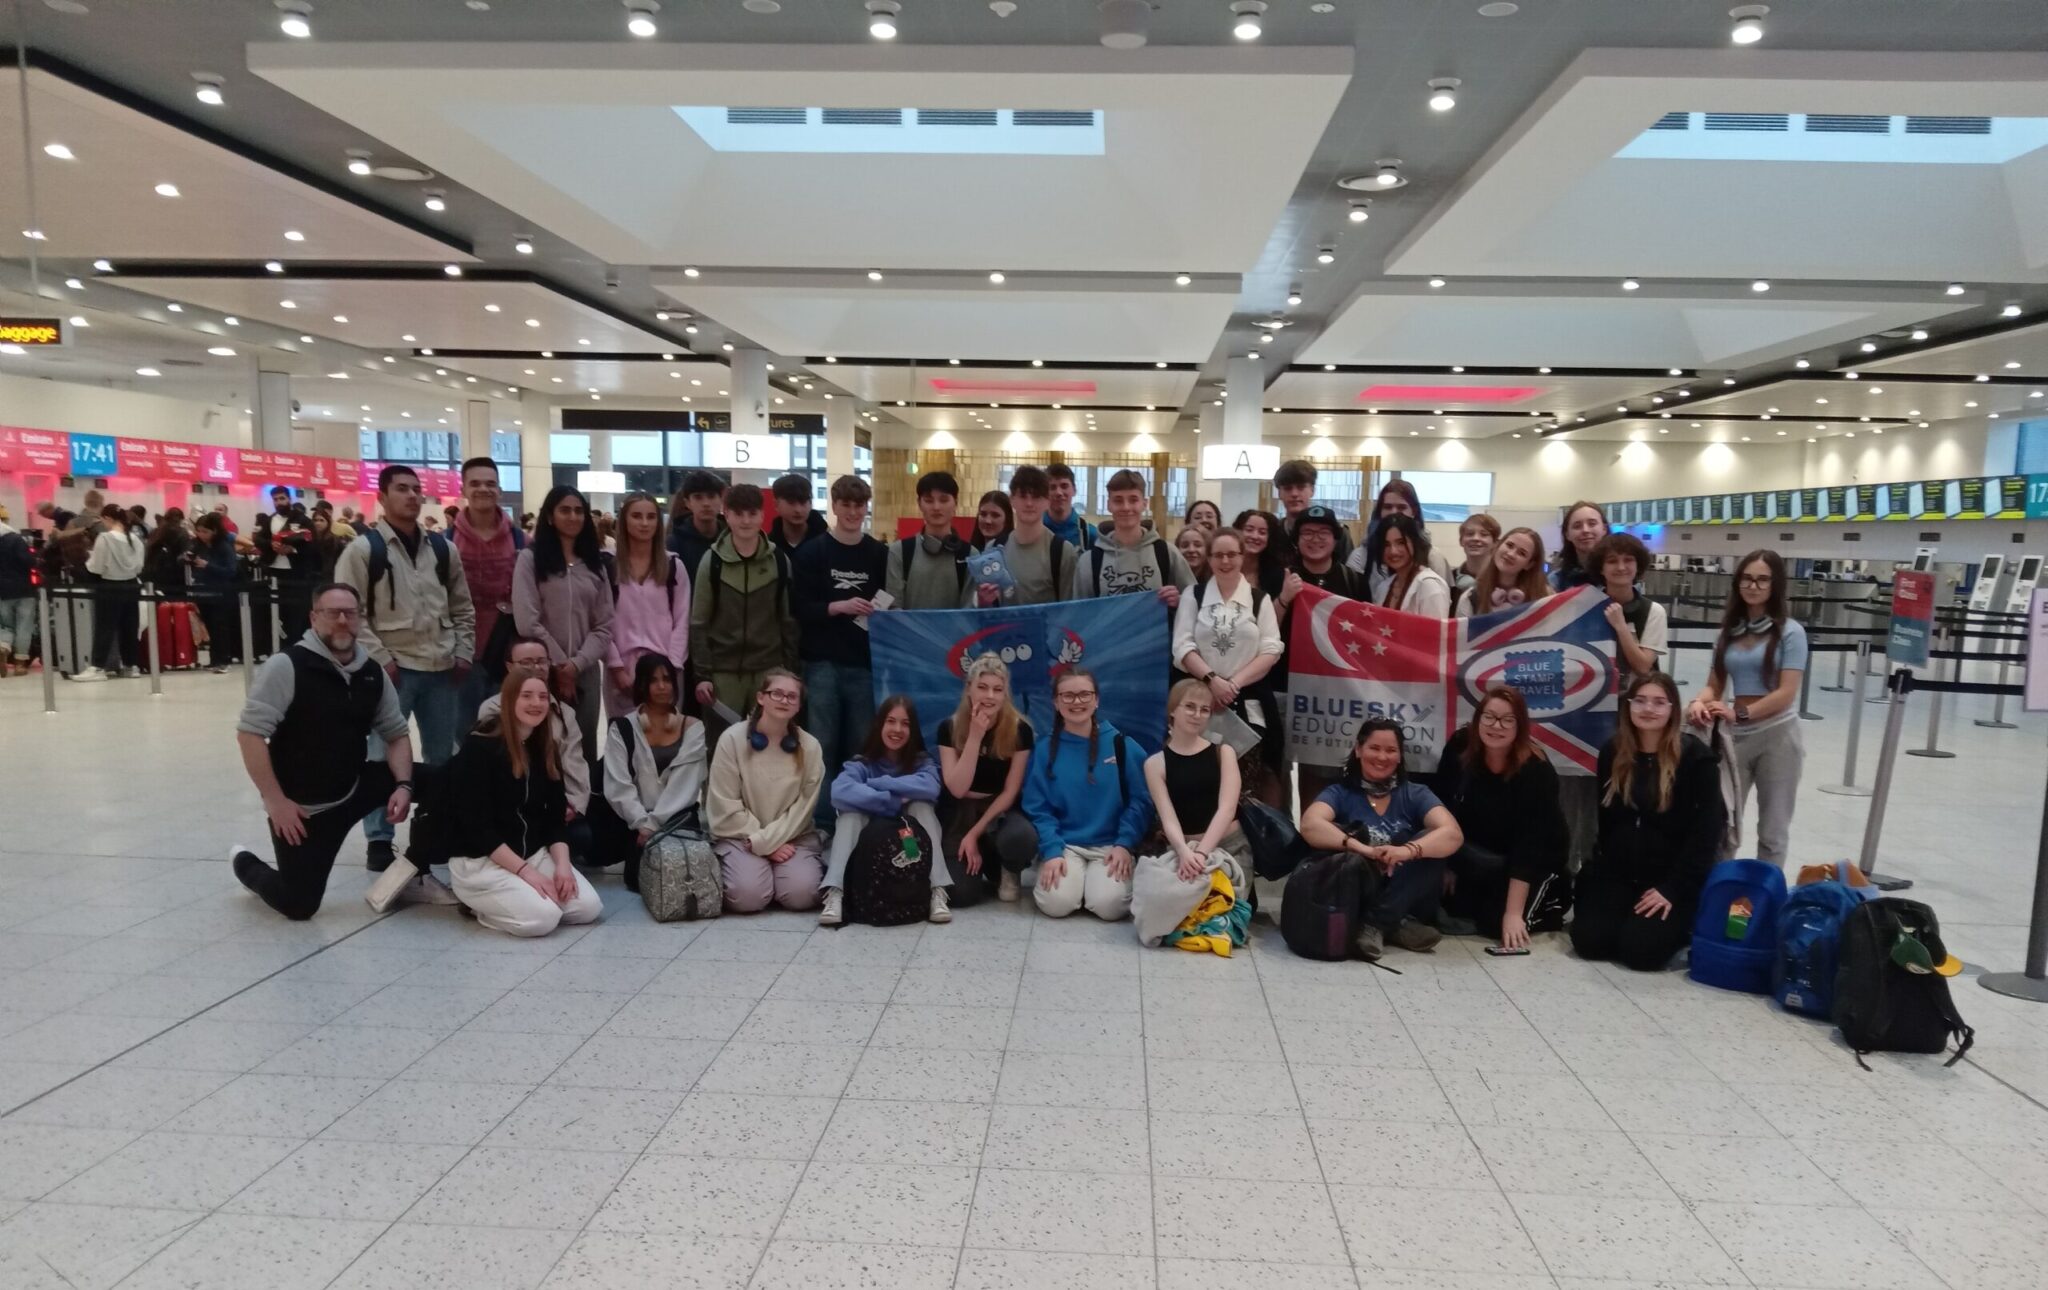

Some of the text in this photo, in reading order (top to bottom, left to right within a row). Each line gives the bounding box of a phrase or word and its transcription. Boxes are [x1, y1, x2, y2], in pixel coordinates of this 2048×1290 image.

[0, 326, 57, 343] aggage
[768, 419, 796, 429] ures
[71, 441, 114, 464] 17:41
[735, 440, 750, 463] B
[1234, 450, 1252, 473] A
[2029, 482, 2048, 504] 17
[831, 568, 870, 580] Reebok
[1518, 661, 1551, 672] BLUE
[1514, 673, 1555, 684] STAMP
[1293, 694, 1435, 723] BLUESKY
[1291, 715, 1435, 743] EDUCON
[1291, 735, 1433, 755] BE FUTU ADY
